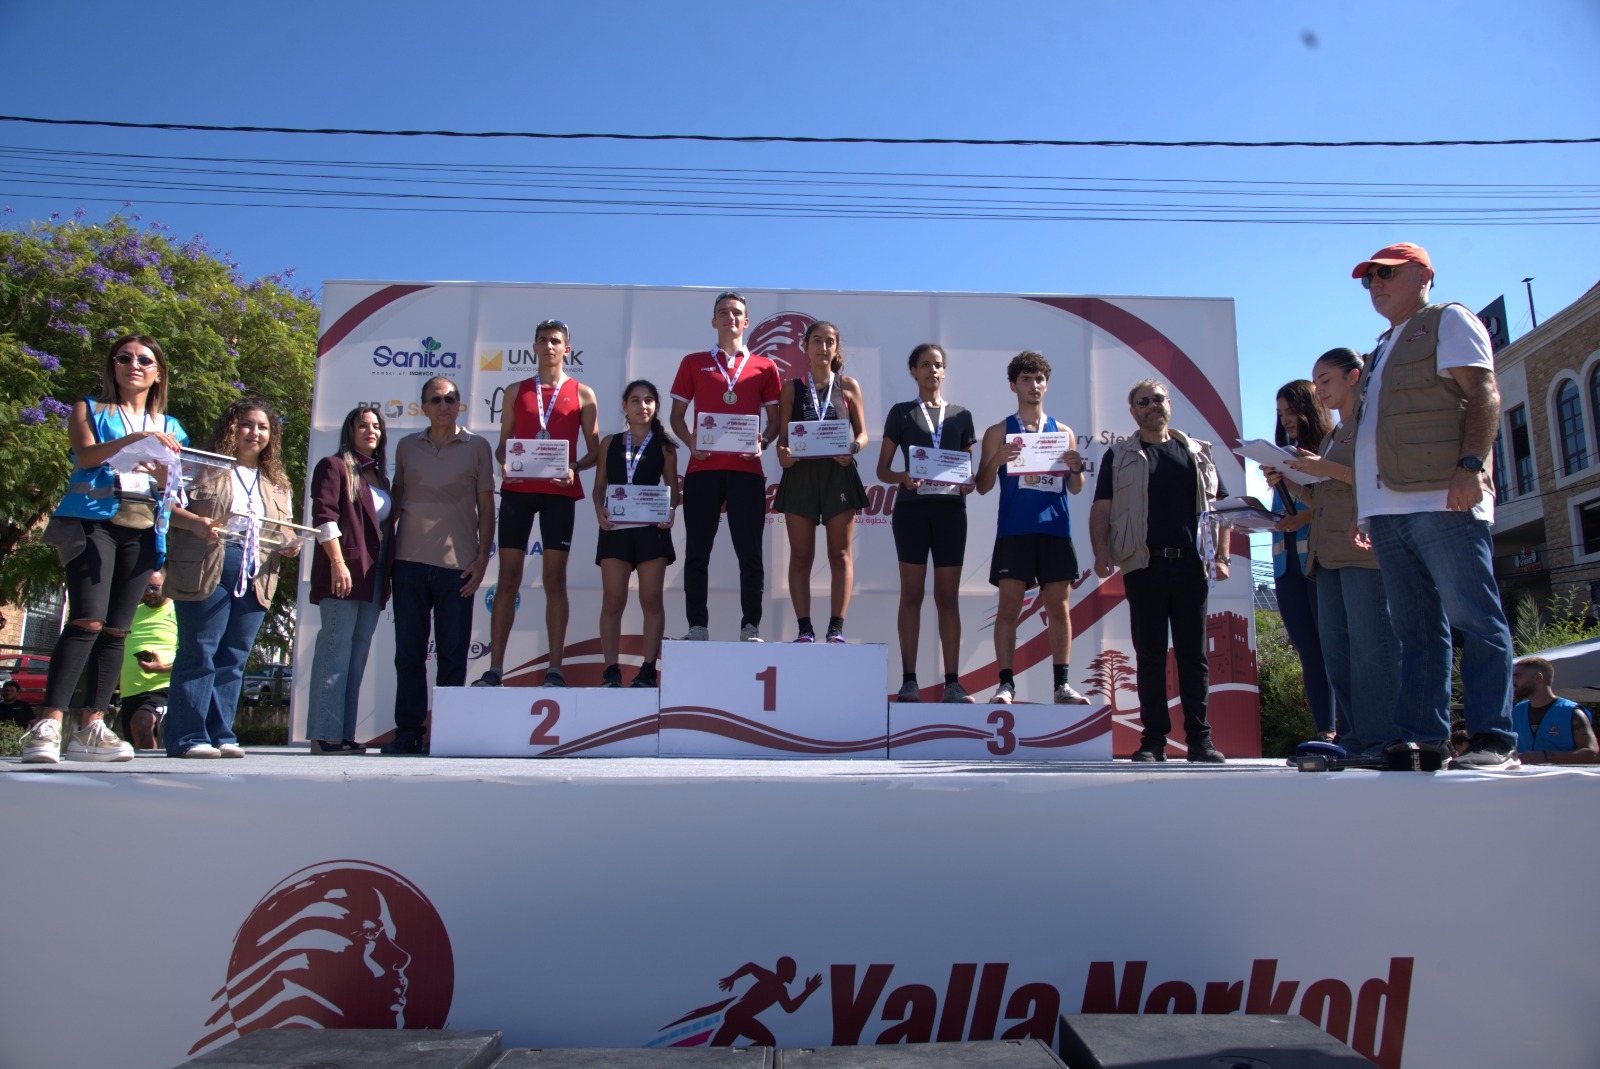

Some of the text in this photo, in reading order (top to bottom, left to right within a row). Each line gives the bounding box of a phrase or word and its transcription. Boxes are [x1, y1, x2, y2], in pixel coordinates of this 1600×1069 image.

[373, 345, 457, 369] Sanita
[508, 349, 584, 366] UNK
[1100, 430, 1130, 446] Ste
[755, 665, 777, 712] 1
[529, 699, 561, 745] 2
[986, 710, 1016, 755] 3
[830, 963, 1061, 1048] Yalla
